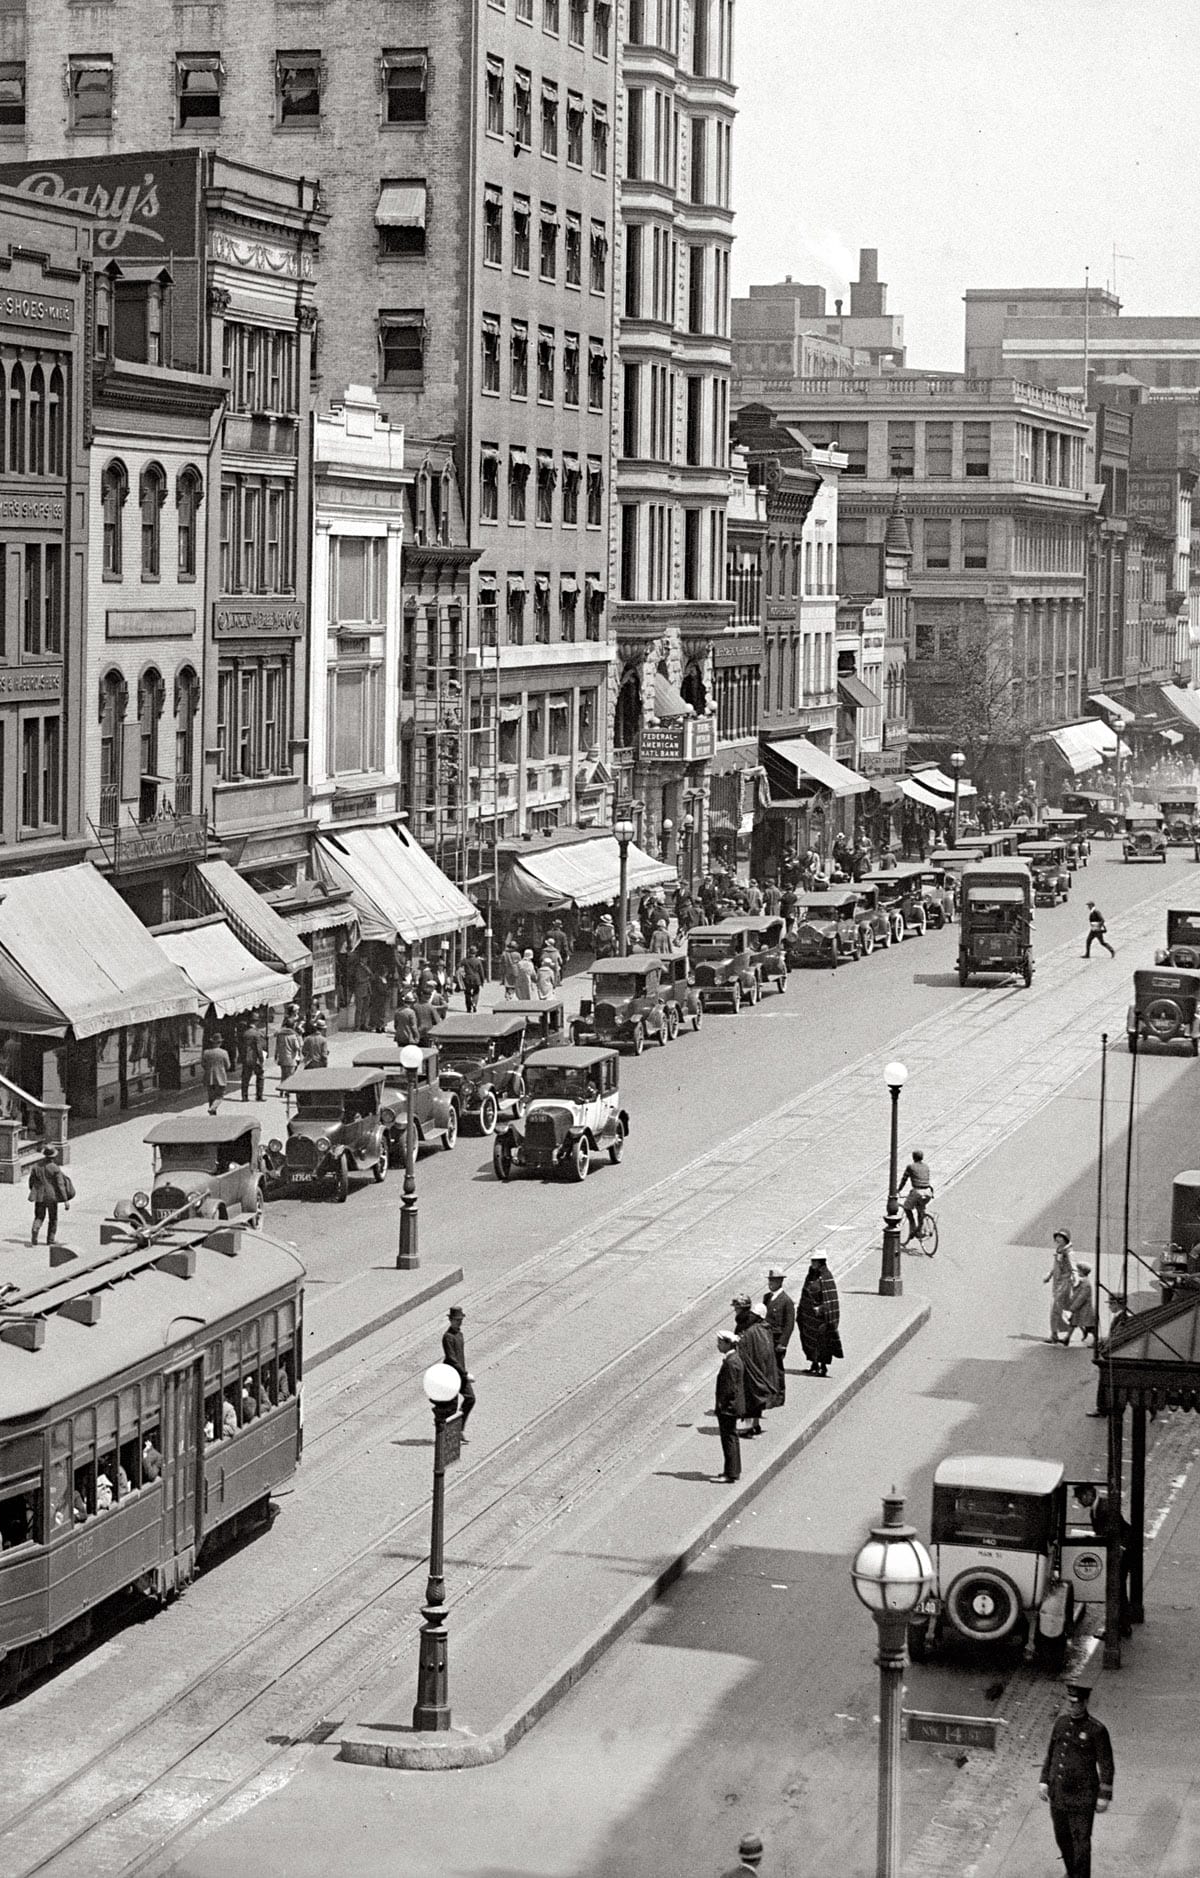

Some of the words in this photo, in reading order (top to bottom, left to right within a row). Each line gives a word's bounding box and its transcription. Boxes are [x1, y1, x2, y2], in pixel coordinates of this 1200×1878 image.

[5, 296, 46, 320] SHOES
[641, 741, 679, 749] AMERICAN
[660, 749, 680, 757] BANK
[945, 1725, 962, 1742] 14
